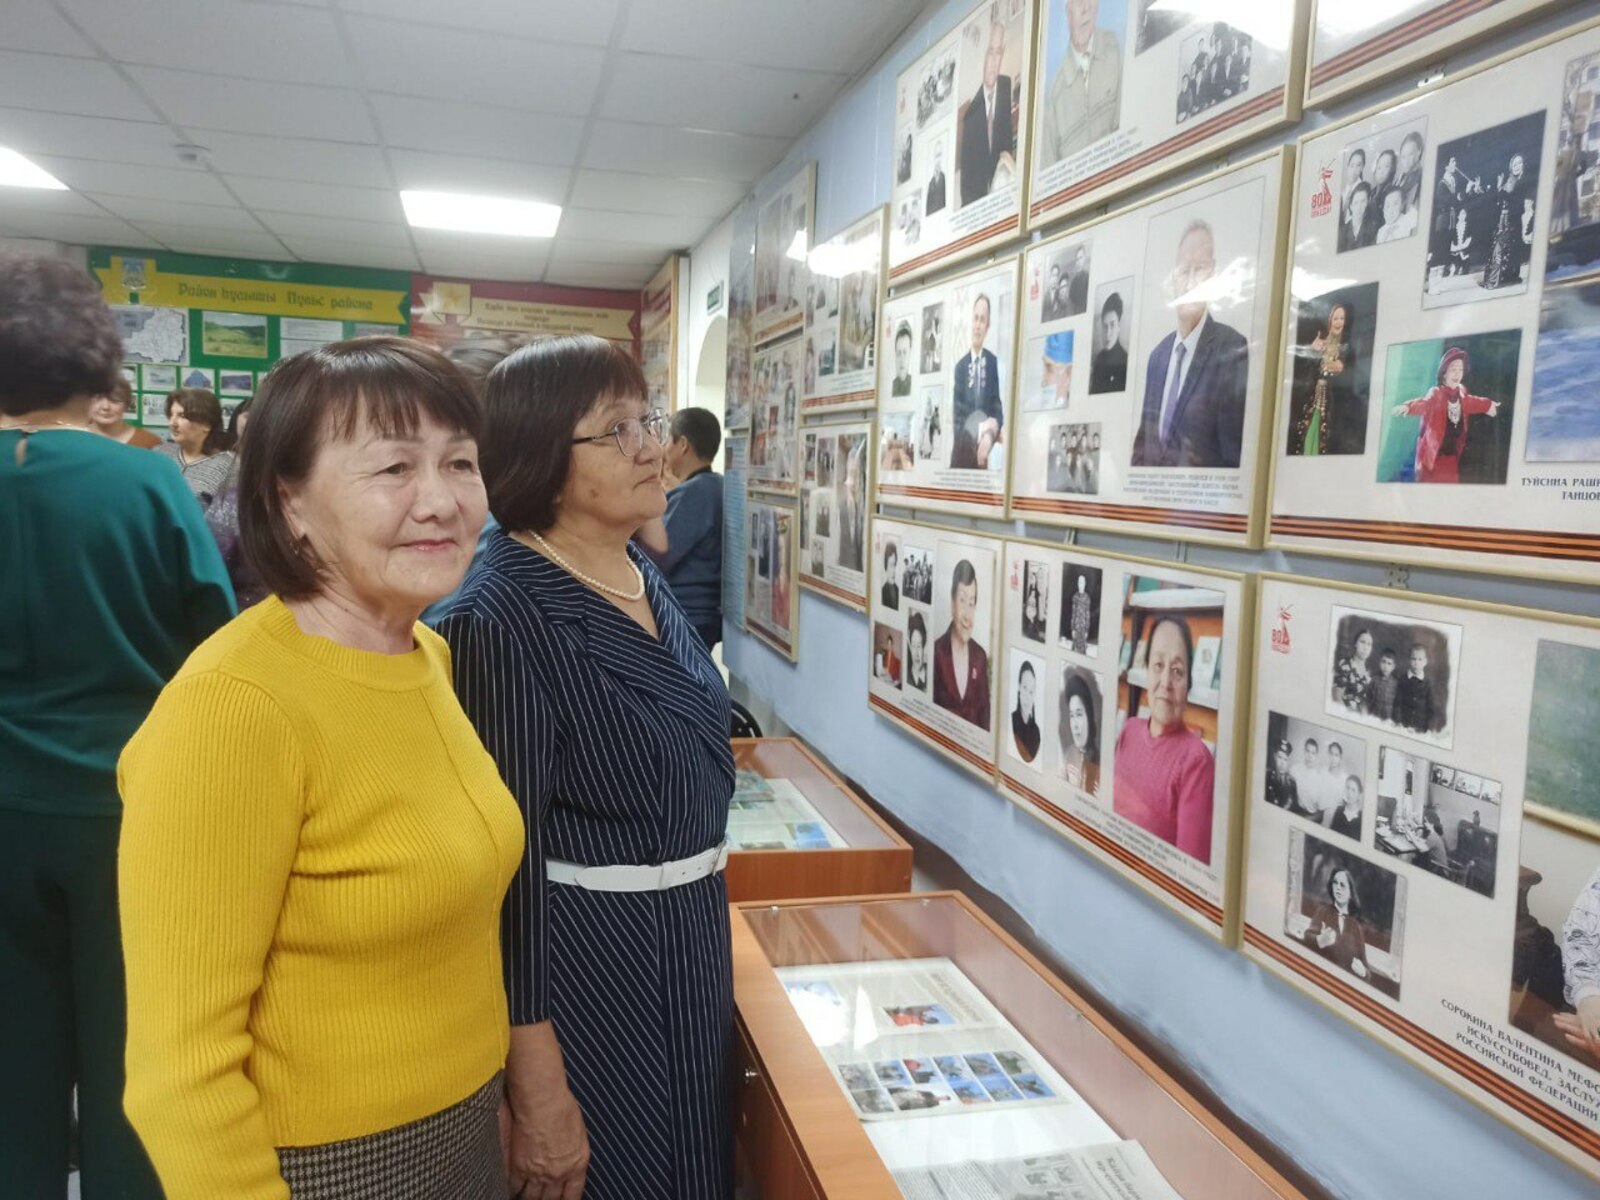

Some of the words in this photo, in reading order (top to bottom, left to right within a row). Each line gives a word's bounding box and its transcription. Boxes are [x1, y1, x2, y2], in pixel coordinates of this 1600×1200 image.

[1441, 998, 1494, 1035] СОРОКИНА
[1497, 1030, 1563, 1073] ВАЛЕНТИНА
[1455, 1031, 1525, 1079] РОССИЙСКОЙ
[1527, 1074, 1598, 1121] ФЕДЕРАЦИИ
